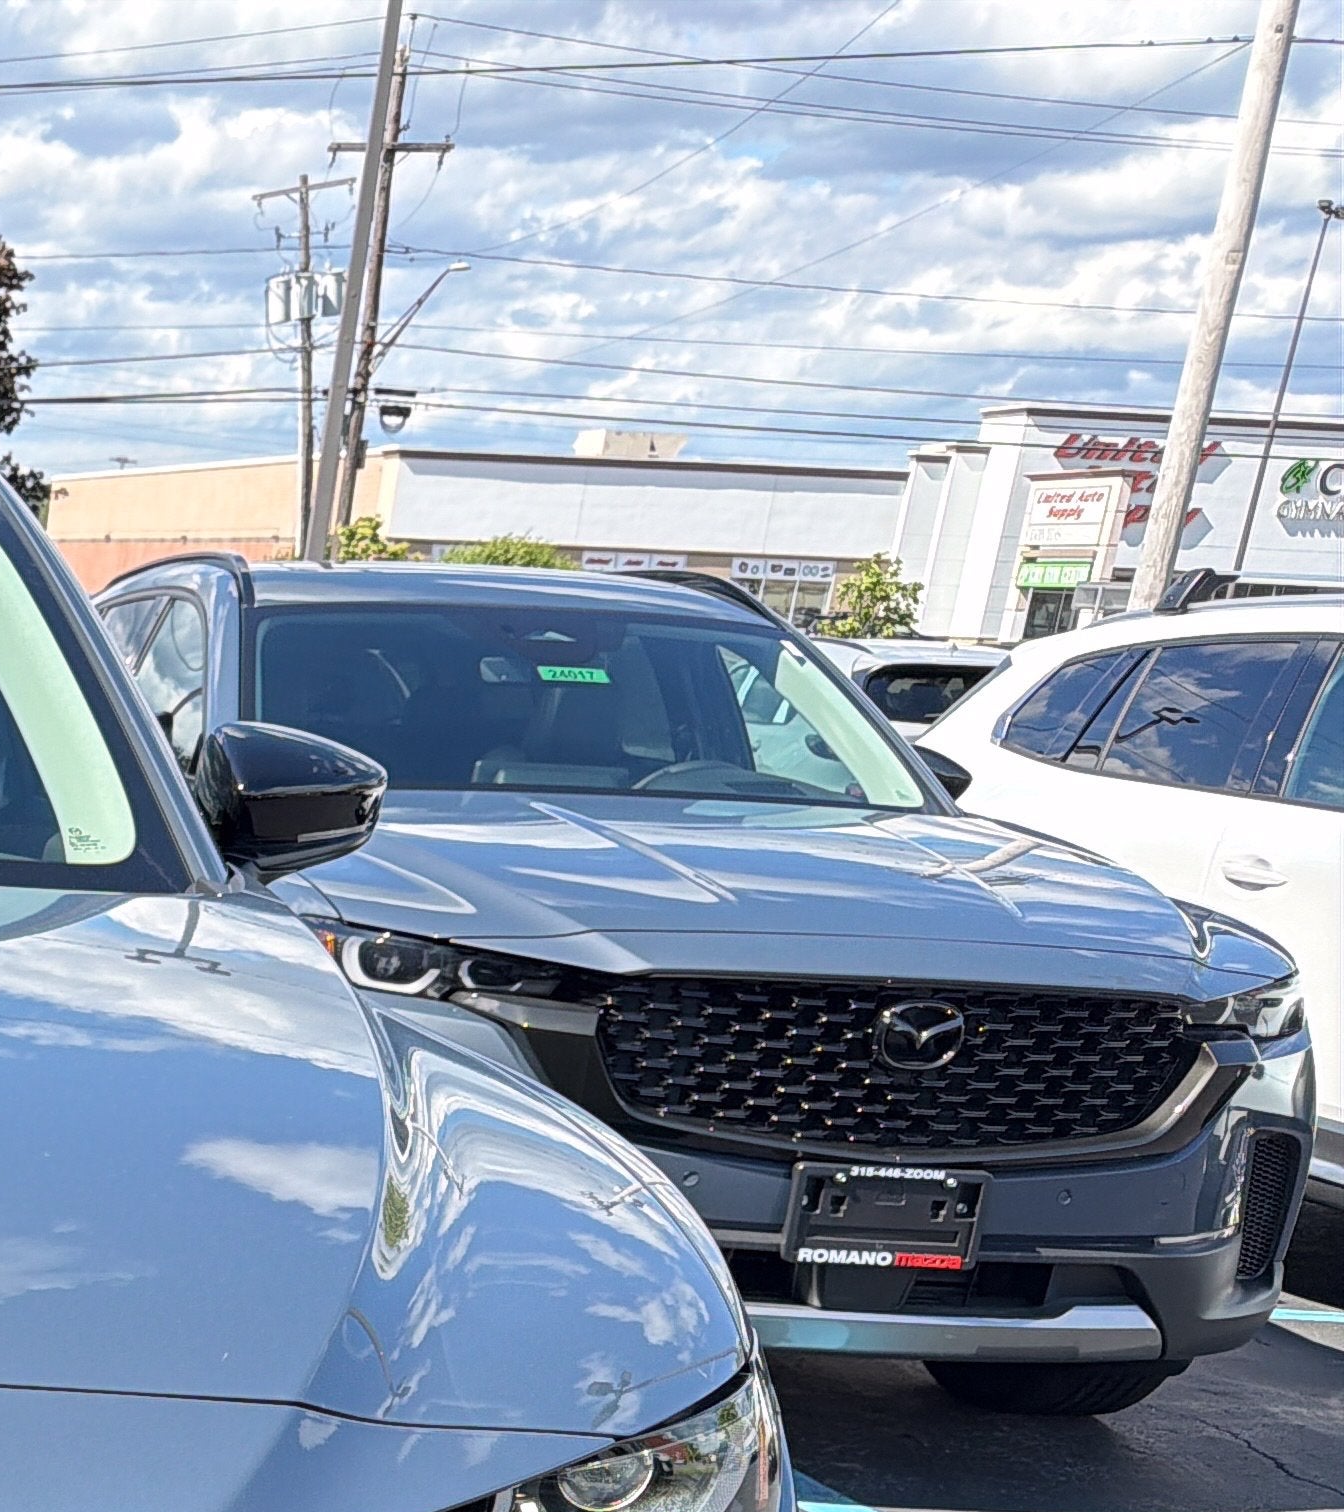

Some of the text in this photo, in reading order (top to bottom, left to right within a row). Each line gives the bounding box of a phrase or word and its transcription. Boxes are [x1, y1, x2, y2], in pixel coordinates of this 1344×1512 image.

[1037, 491, 1104, 504] United Auto
[1046, 505, 1085, 520] Supply
[797, 1248, 893, 1266] ROMANO
